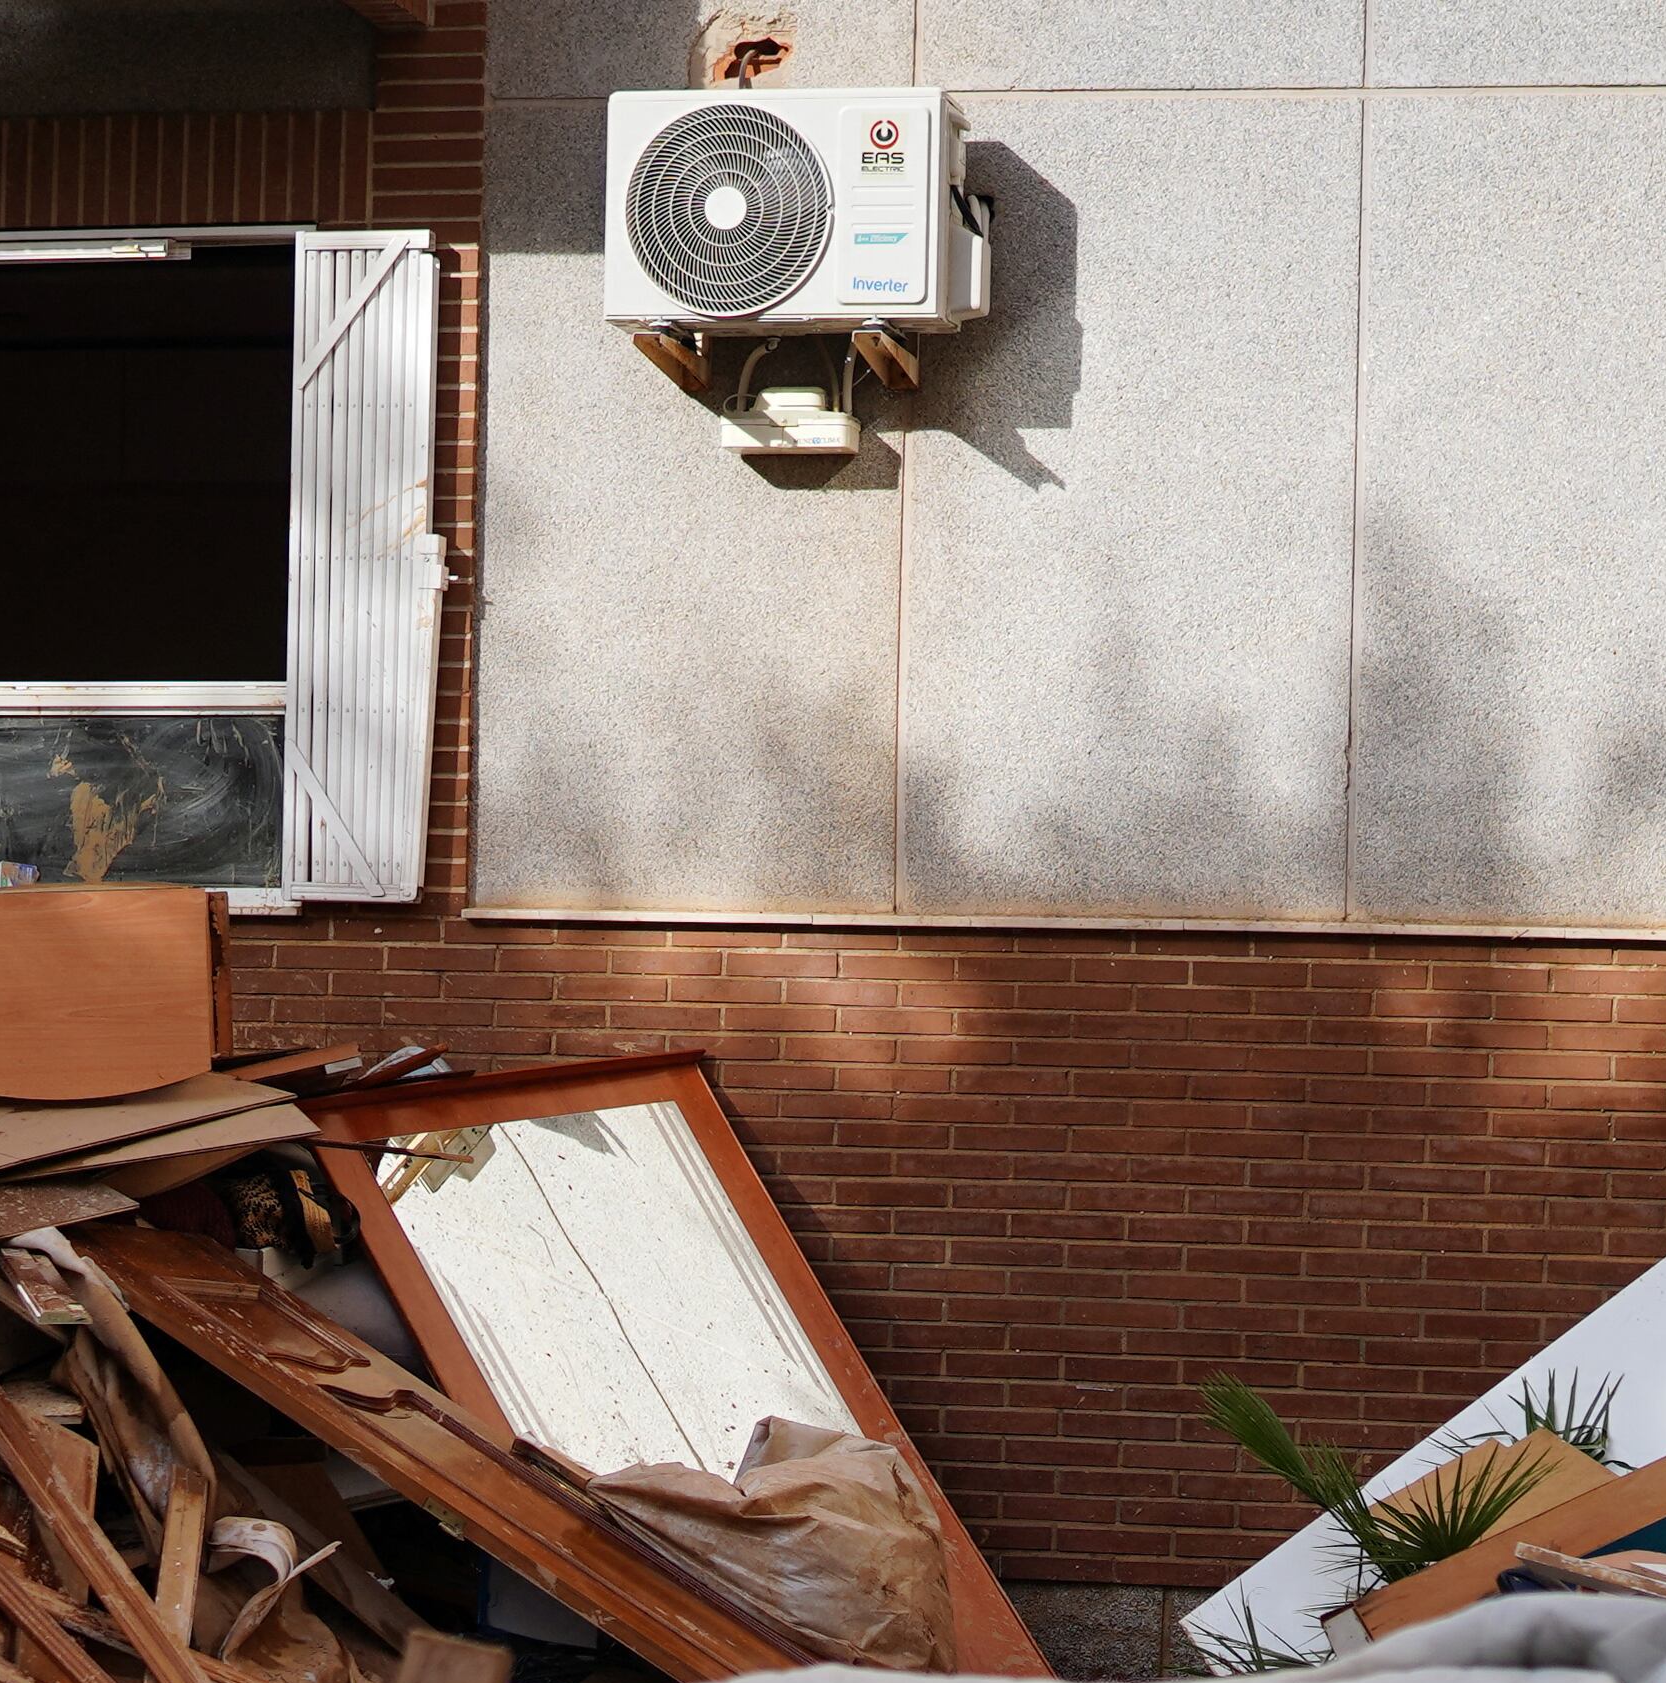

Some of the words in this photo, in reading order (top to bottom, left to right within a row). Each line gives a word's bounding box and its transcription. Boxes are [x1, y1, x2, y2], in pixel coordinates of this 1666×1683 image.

[862, 151, 905, 164] EAS
[861, 165, 905, 173] ELECTRIC
[852, 276, 909, 292] Inverter
